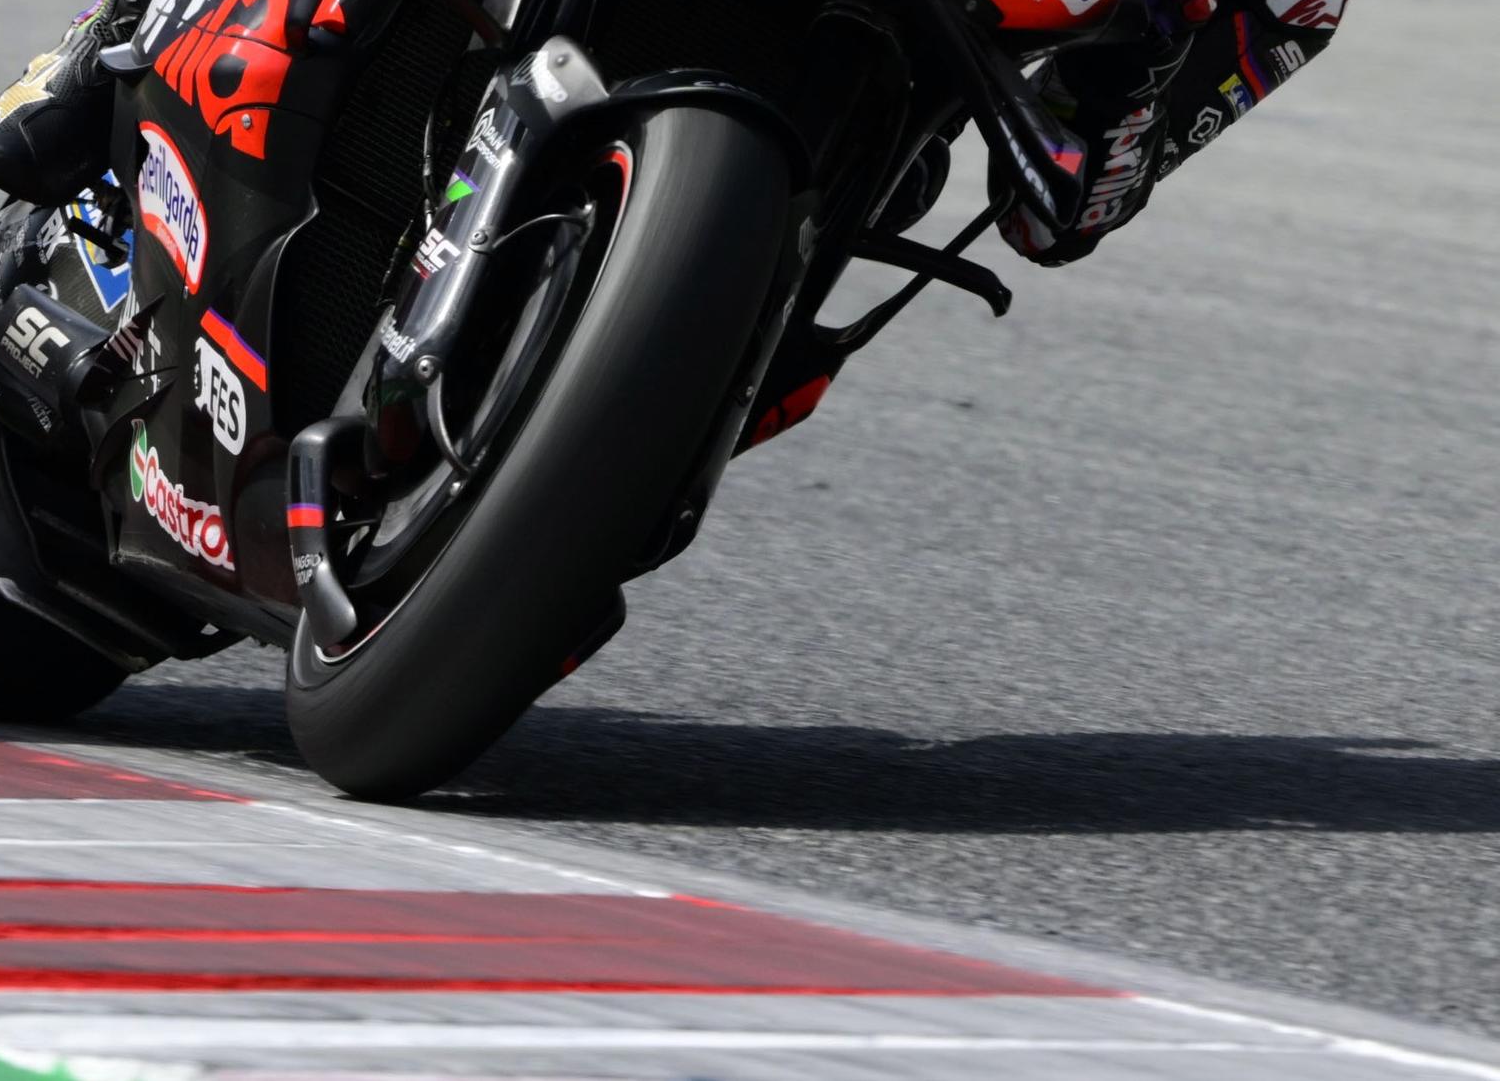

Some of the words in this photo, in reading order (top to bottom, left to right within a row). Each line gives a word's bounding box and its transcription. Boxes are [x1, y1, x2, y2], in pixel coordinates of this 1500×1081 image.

[422, 230, 461, 268] SC
[1, 336, 43, 379] PROJECT
[5, 307, 71, 368] SC
[146, 454, 234, 564] Castro
